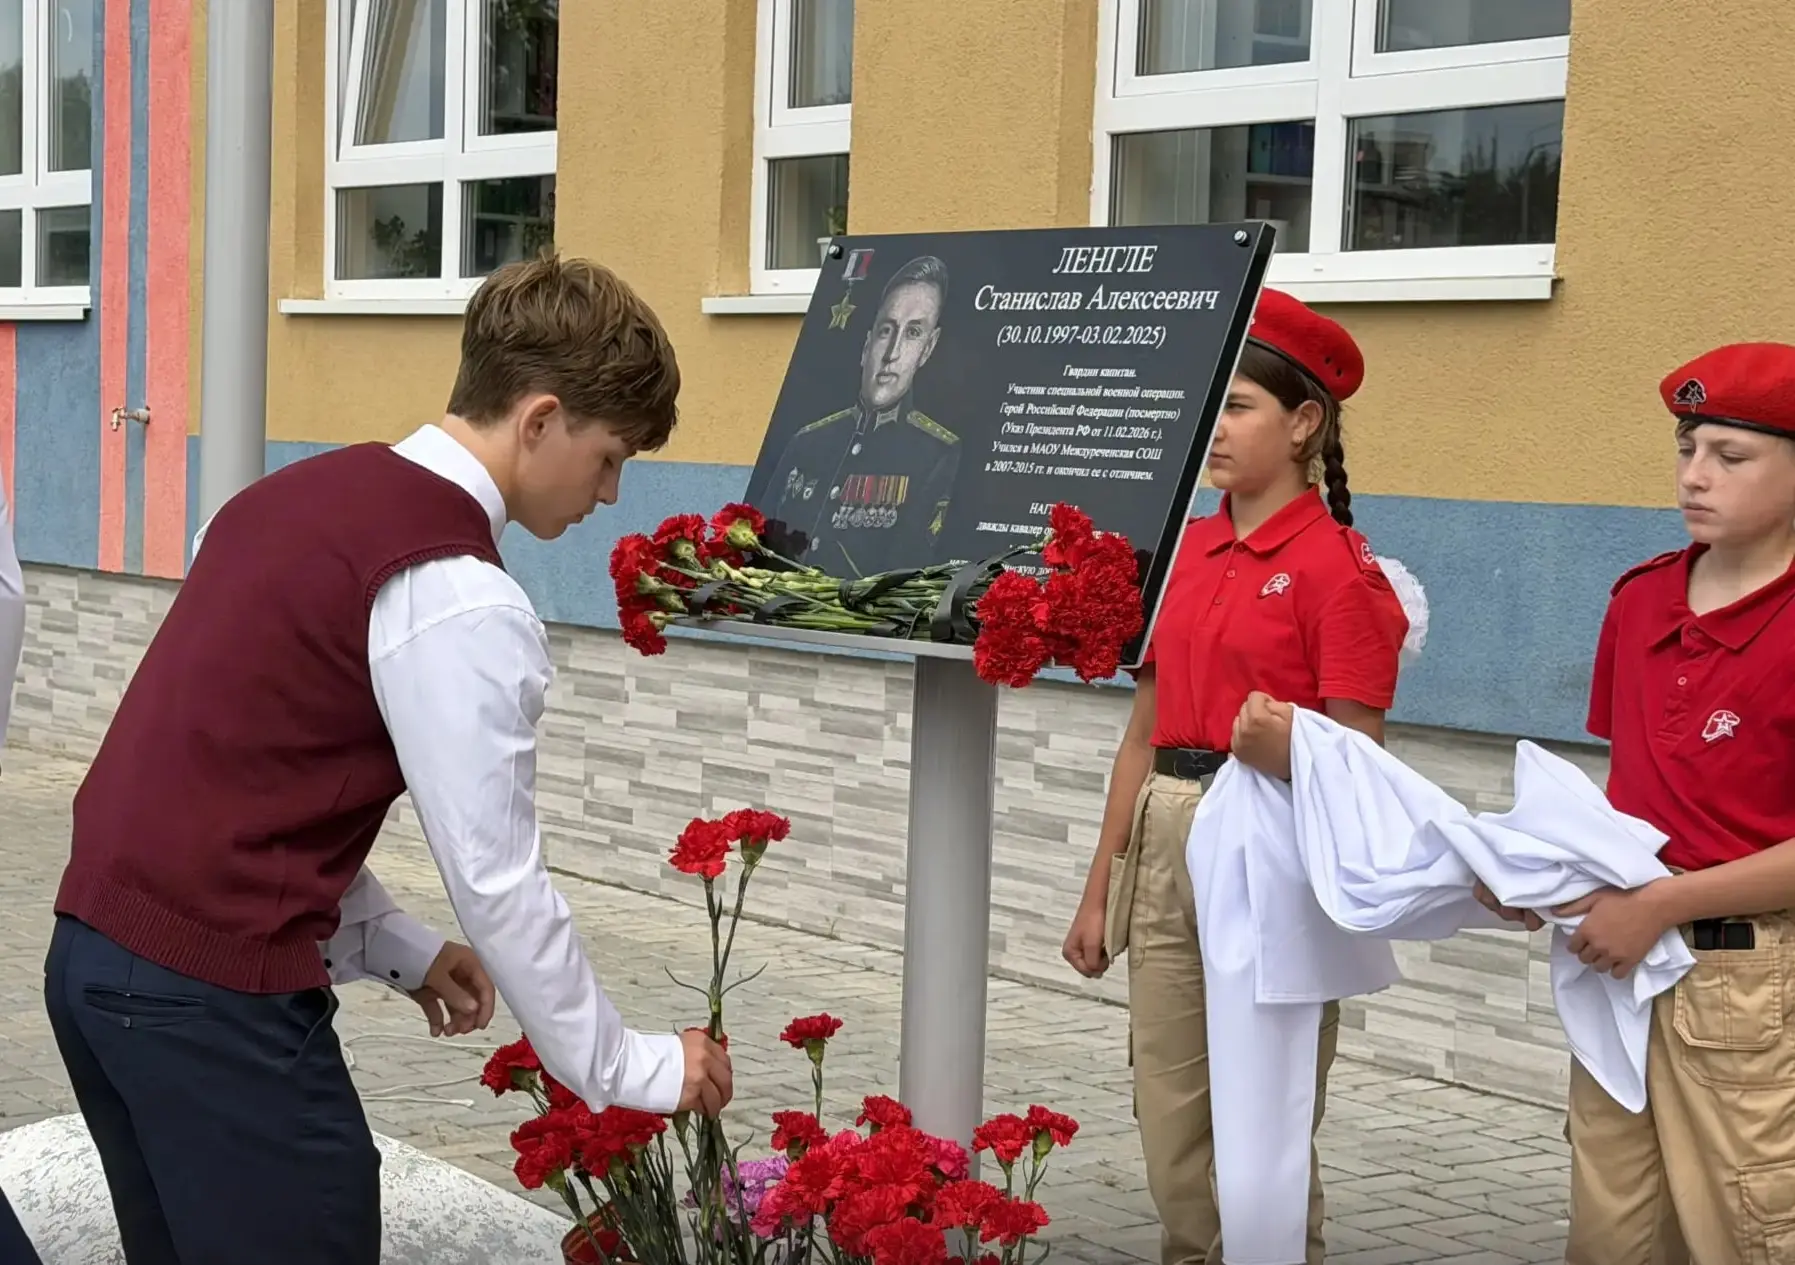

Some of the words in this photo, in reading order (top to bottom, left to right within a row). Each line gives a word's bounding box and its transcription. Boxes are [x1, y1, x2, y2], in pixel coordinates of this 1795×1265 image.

[1052, 244, 1158, 274] ЛЕНГЛЕ
[974, 284, 1083, 311] Станислав
[1085, 284, 1220, 311] Алексеевич
[996, 324, 1167, 350] (30.10.1997-03.02.2025)
[1099, 367, 1137, 378] капитан.
[1006, 382, 1047, 396] Участник
[1047, 384, 1103, 397] специальной
[1102, 386, 1141, 398] военной
[1140, 388, 1186, 402] операции.
[999, 401, 1026, 417] Герой
[1025, 402, 1076, 417] Российской
[1076, 404, 1125, 420] Федерации
[1124, 405, 1181, 422] (посмертно)
[1001, 421, 1025, 436] (Указ
[1025, 422, 1075, 437] Президента
[1075, 424, 1091, 437] РФ
[1091, 428, 1103, 437] от
[992, 440, 1023, 454] Учился
[1023, 445, 1030, 454] в
[1029, 442, 1061, 455] МАОУ
[1060, 444, 1135, 460] Междуреченская
[1135, 447, 1164, 460] СОШ
[984, 462, 991, 472] в
[991, 460, 1036, 474] 2007-2015
[1046, 466, 1054, 475] и
[1053, 466, 1091, 477] окончил
[1102, 469, 1109, 477] с
[1109, 469, 1154, 481] отличием.
[975, 521, 1010, 533] дважды
[1009, 524, 1043, 538] кавалер
